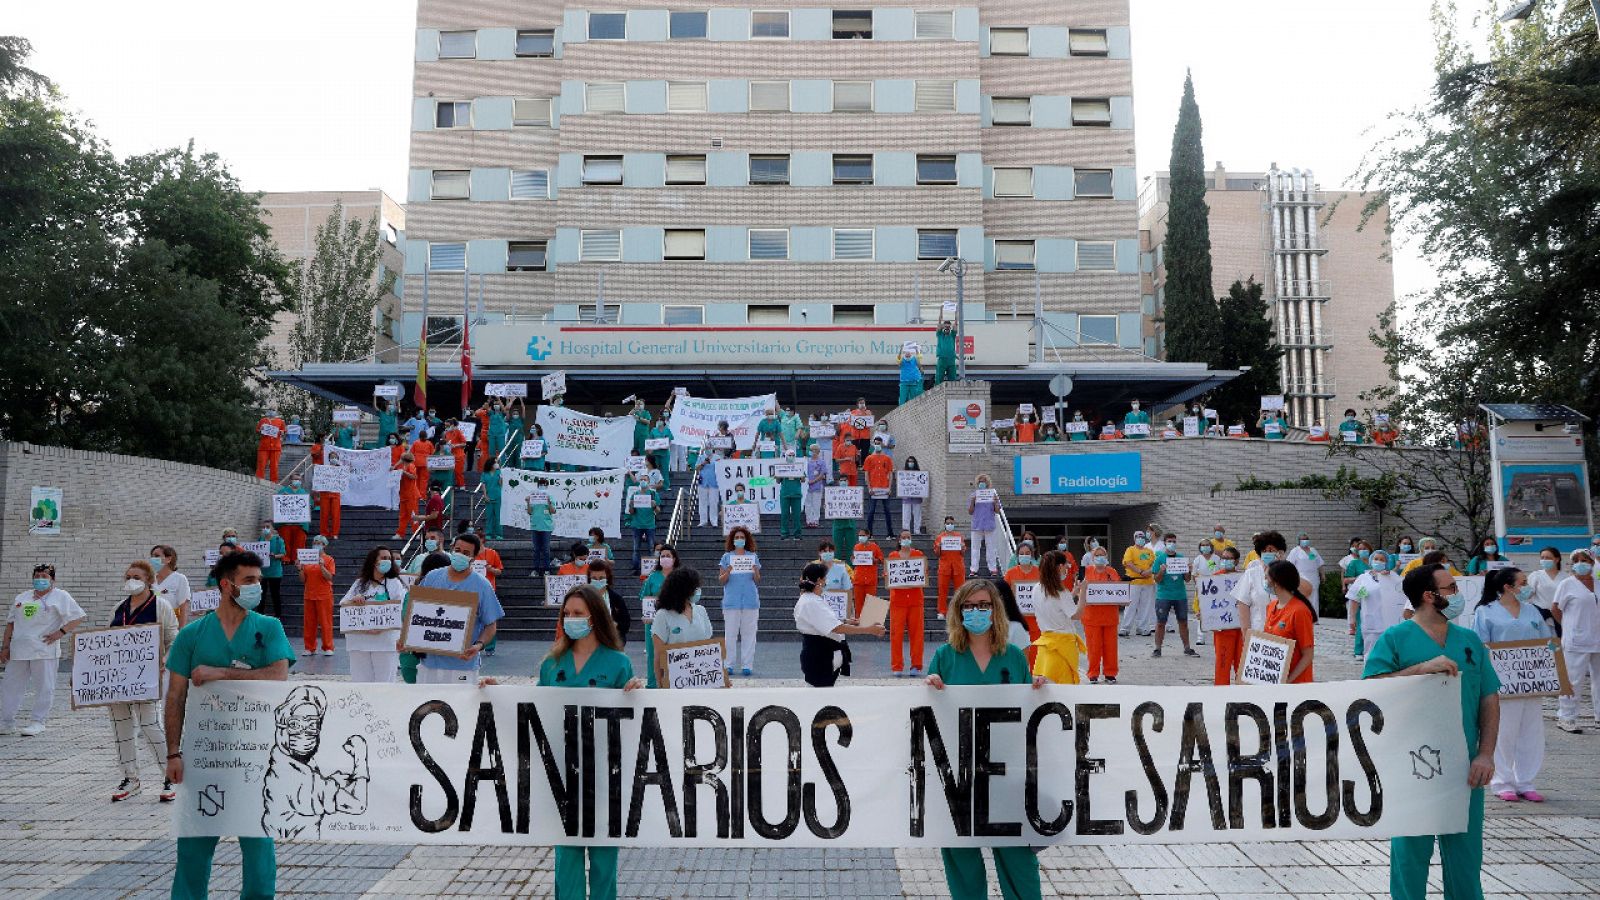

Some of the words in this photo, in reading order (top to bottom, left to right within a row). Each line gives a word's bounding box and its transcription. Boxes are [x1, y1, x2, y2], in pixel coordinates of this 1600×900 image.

[560, 340, 622, 358] Hospital
[628, 340, 687, 354] General
[694, 340, 791, 354] Universitario
[796, 340, 865, 358] Gregorio
[870, 340, 937, 354] Marón
[1058, 475, 1128, 488] Radiología
[88, 653, 111, 665] PARA
[114, 646, 155, 664] TODOS
[1492, 647, 1552, 660] NOSOTROS
[1496, 662, 1511, 672] OS
[1512, 658, 1556, 671] CUIDAMOS
[81, 667, 127, 685] JUSTAS
[137, 665, 146, 679] Y
[1518, 670, 1535, 680] NO
[75, 682, 147, 703] TRANSPARENTES
[1499, 680, 1561, 695] OLVIDAMOS
[409, 699, 853, 840] SANITARIOS
[908, 698, 1386, 838] NECESARIOS
